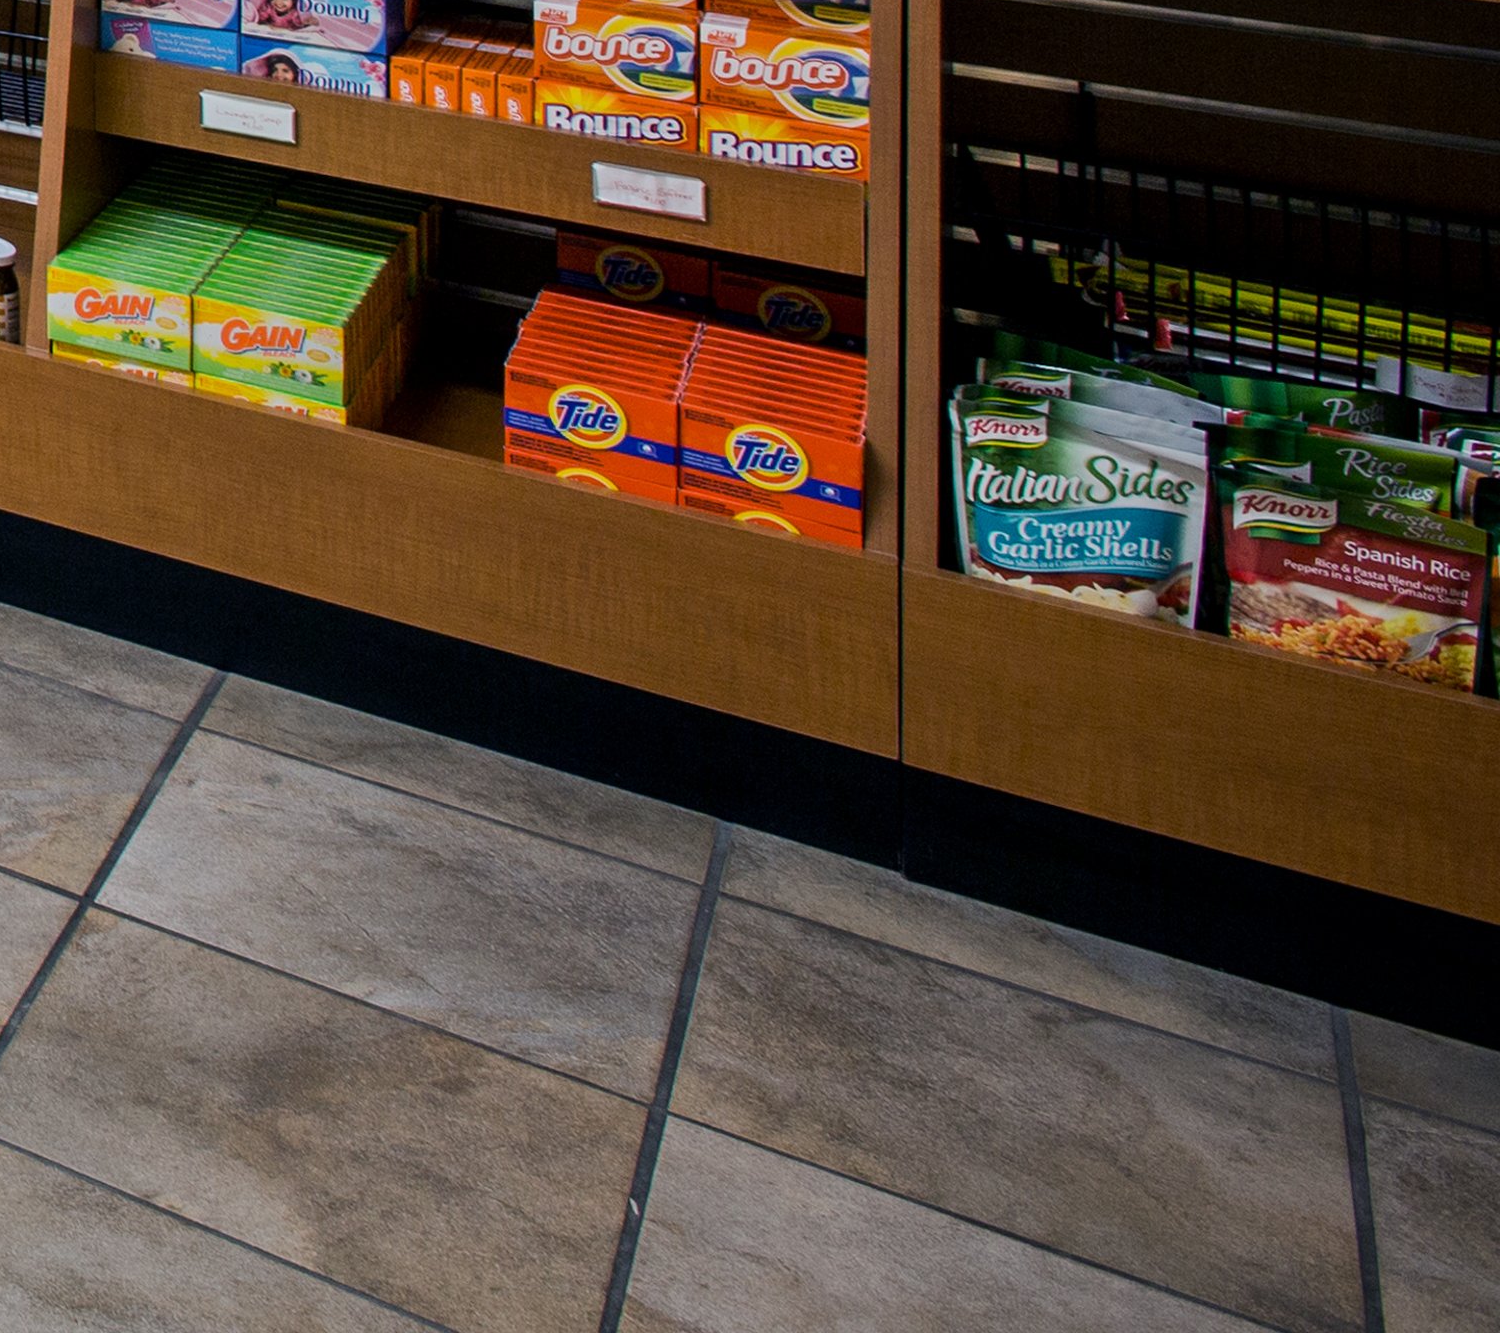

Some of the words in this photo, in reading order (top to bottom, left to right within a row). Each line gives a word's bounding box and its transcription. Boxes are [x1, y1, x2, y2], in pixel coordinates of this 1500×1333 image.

[546, 26, 669, 63] bounce
[713, 49, 841, 86] bounce
[544, 104, 684, 143] Bounce
[710, 131, 858, 171] Bounce
[603, 256, 659, 286] Tide
[73, 286, 156, 323] GAIN
[219, 316, 303, 355] GAIN
[555, 398, 619, 433] Tide
[968, 417, 1045, 442] Knorr
[734, 439, 801, 474] Tide
[1336, 446, 1406, 478] Rice
[966, 459, 1084, 505] Italian
[1084, 453, 1196, 506] Sides
[1372, 474, 1436, 504] Sides
[1234, 493, 1333, 521] Knorr
[1363, 498, 1446, 531] Fiesta
[1016, 516, 1132, 541] Creamy
[988, 532, 1082, 563] Garlic
[1084, 536, 1174, 562] Shells
[1343, 540, 1426, 574] Spanish
[1430, 559, 1473, 582] Rice
[1282, 558, 1330, 580] Peppers
[1331, 569, 1343, 580] in
[1353, 574, 1390, 593] Sweet
[1391, 583, 1436, 603] Tomato
[1437, 593, 1469, 608] Sauce
[1315, 557, 1338, 572] Rice
[1352, 565, 1385, 582] Pasta
[1387, 573, 1421, 591] Blend
[1422, 582, 1448, 596] with
